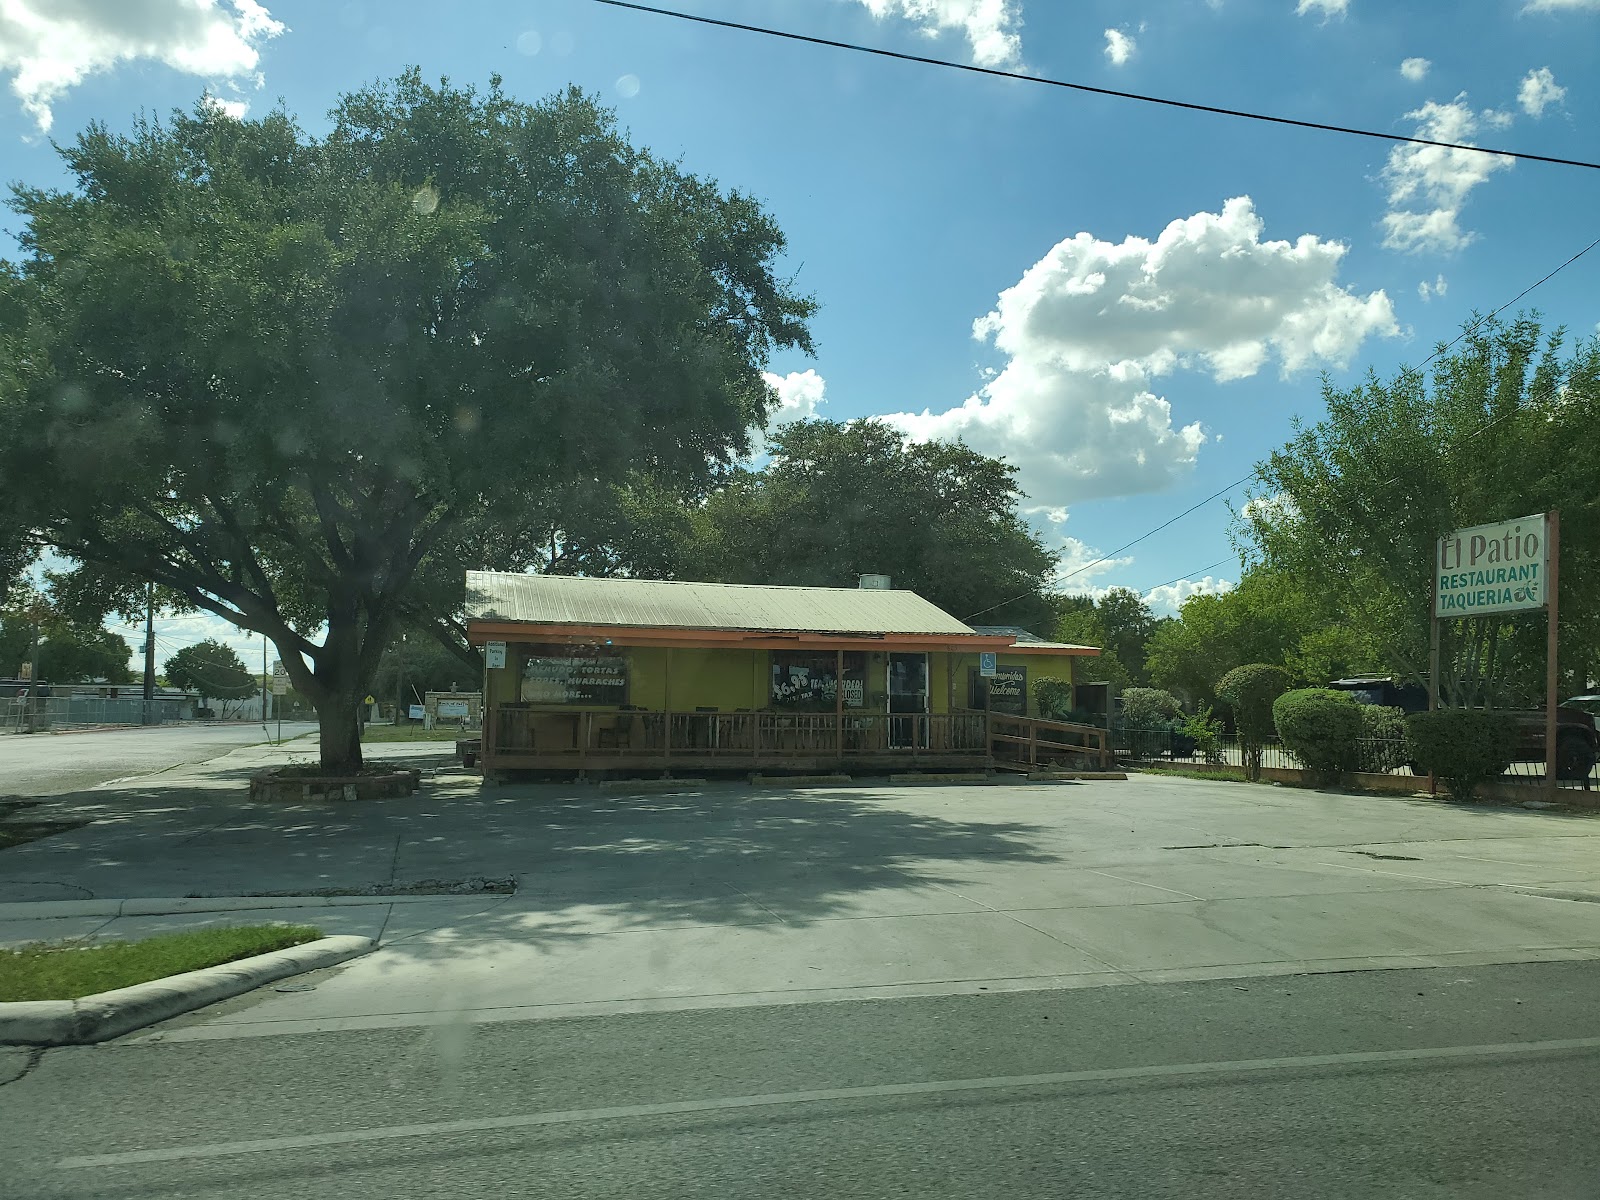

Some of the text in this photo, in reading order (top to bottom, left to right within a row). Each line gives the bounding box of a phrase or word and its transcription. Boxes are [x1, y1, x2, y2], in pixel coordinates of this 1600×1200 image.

[1441, 525, 1539, 570] El Patio
[1440, 563, 1539, 590] RESTAURANT
[1440, 587, 1513, 610] TAQUERIA
[581, 667, 619, 675] TORTAS
[567, 677, 625, 687] HUARACHES
[842, 690, 863, 699] LOSED
